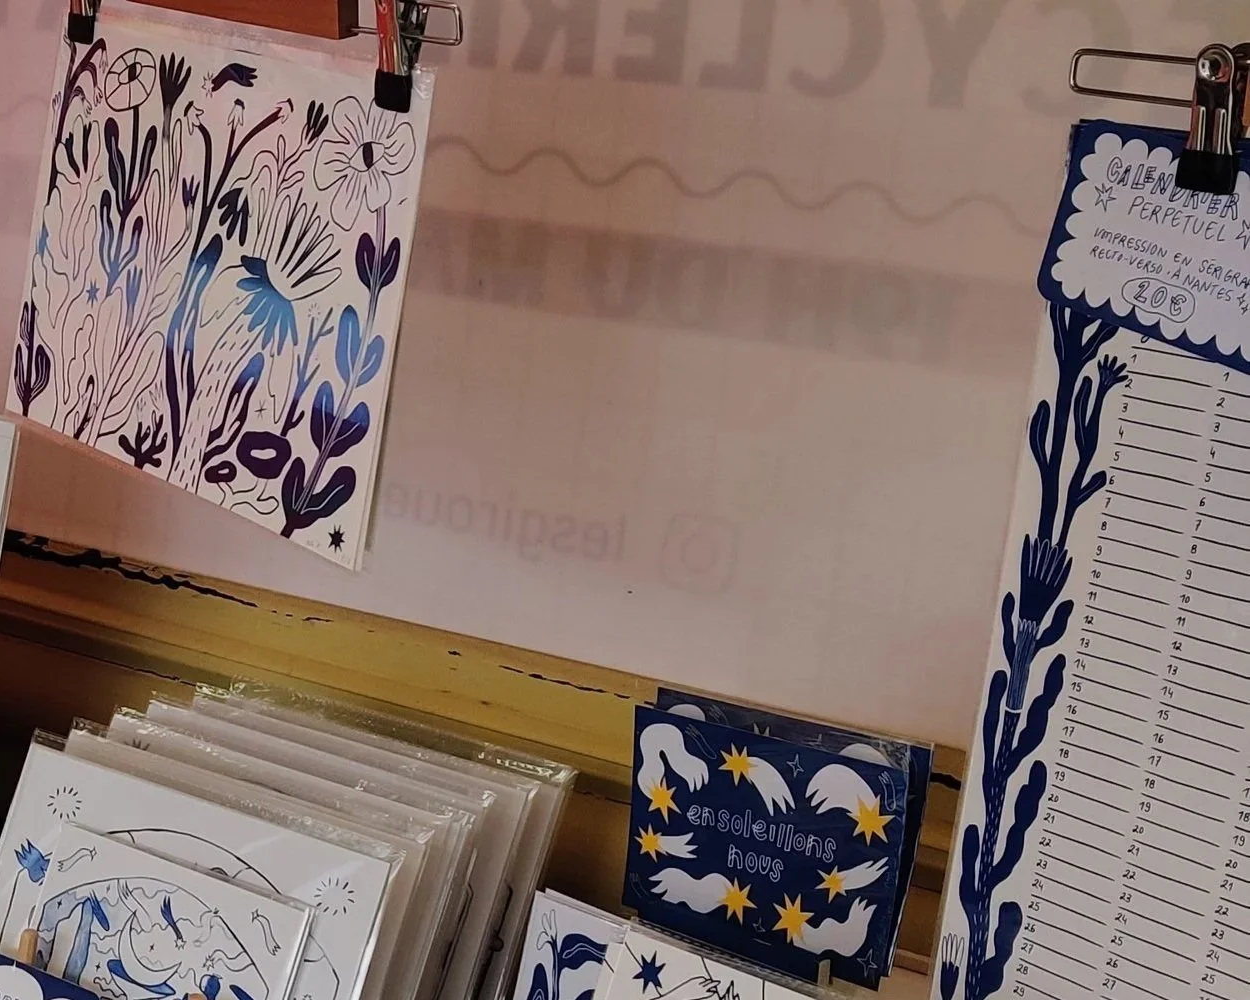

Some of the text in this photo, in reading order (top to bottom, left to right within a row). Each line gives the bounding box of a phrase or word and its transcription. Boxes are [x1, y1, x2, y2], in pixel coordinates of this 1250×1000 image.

[1094, 226, 1168, 258] IMPRESSION
[1173, 252, 1192, 266] EN
[1184, 275, 1232, 302] NANTES
[1134, 281, 1188, 316] 20€
[1130, 353, 1138, 364] 1
[1223, 371, 1230, 382] 1
[1124, 378, 1133, 390] 2
[1121, 402, 1129, 413] 3
[1215, 396, 1226, 409] 2
[1118, 425, 1125, 440] 4
[1213, 421, 1221, 433] 3
[1113, 450, 1121, 462] 5
[1209, 446, 1216, 459] 4
[1108, 474, 1116, 486] 6
[1204, 471, 1213, 483] 5
[1104, 496, 1112, 509] 7
[1198, 496, 1206, 507] 6
[1100, 520, 1108, 531] 8
[1194, 519, 1203, 532] 7
[1095, 544, 1103, 557] 9
[1190, 543, 1198, 555] 8
[1090, 569, 1102, 580] 10
[1184, 568, 1193, 581] 9
[1087, 590, 1098, 602] 11
[1179, 593, 1191, 604] 10
[1083, 614, 1094, 626] 12
[1175, 616, 1187, 627] 11
[1079, 637, 1091, 649] 13
[1171, 640, 1183, 652] 12
[1073, 658, 1086, 671] 14
[1166, 663, 1179, 676] 13
[1070, 681, 1083, 693] 15
[1160, 685, 1174, 699] 14
[1066, 704, 1078, 715] 16
[1157, 709, 1170, 721] 15
[1061, 725, 1076, 738] 17
[1152, 732, 1165, 744] 16
[1058, 747, 1070, 759] 18
[1147, 755, 1162, 768] 17
[1054, 770, 1066, 782] 19
[1144, 777, 1156, 790] 18
[1047, 793, 1059, 803] 20
[1138, 801, 1152, 813] 19
[1043, 812, 1055, 824] 21
[686, 804, 837, 863] ensoleillons
[1131, 824, 1145, 835] 20
[1038, 836, 1052, 848] 22
[1126, 844, 1140, 857] 21
[727, 844, 784, 882] nous
[1035, 858, 1048, 870] 23
[1121, 869, 1137, 881] 22
[1031, 878, 1044, 892] 24
[1119, 891, 1133, 904] 23
[1027, 900, 1041, 912] 25
[1114, 912, 1128, 925] 24
[1023, 922, 1036, 933] 26
[1110, 935, 1124, 947] 25
[1020, 942, 1034, 955] 27
[1105, 957, 1119, 969] 26
[1015, 963, 1029, 976] 28
[1101, 977, 1117, 991] 27
[1012, 985, 1025, 998] 29
